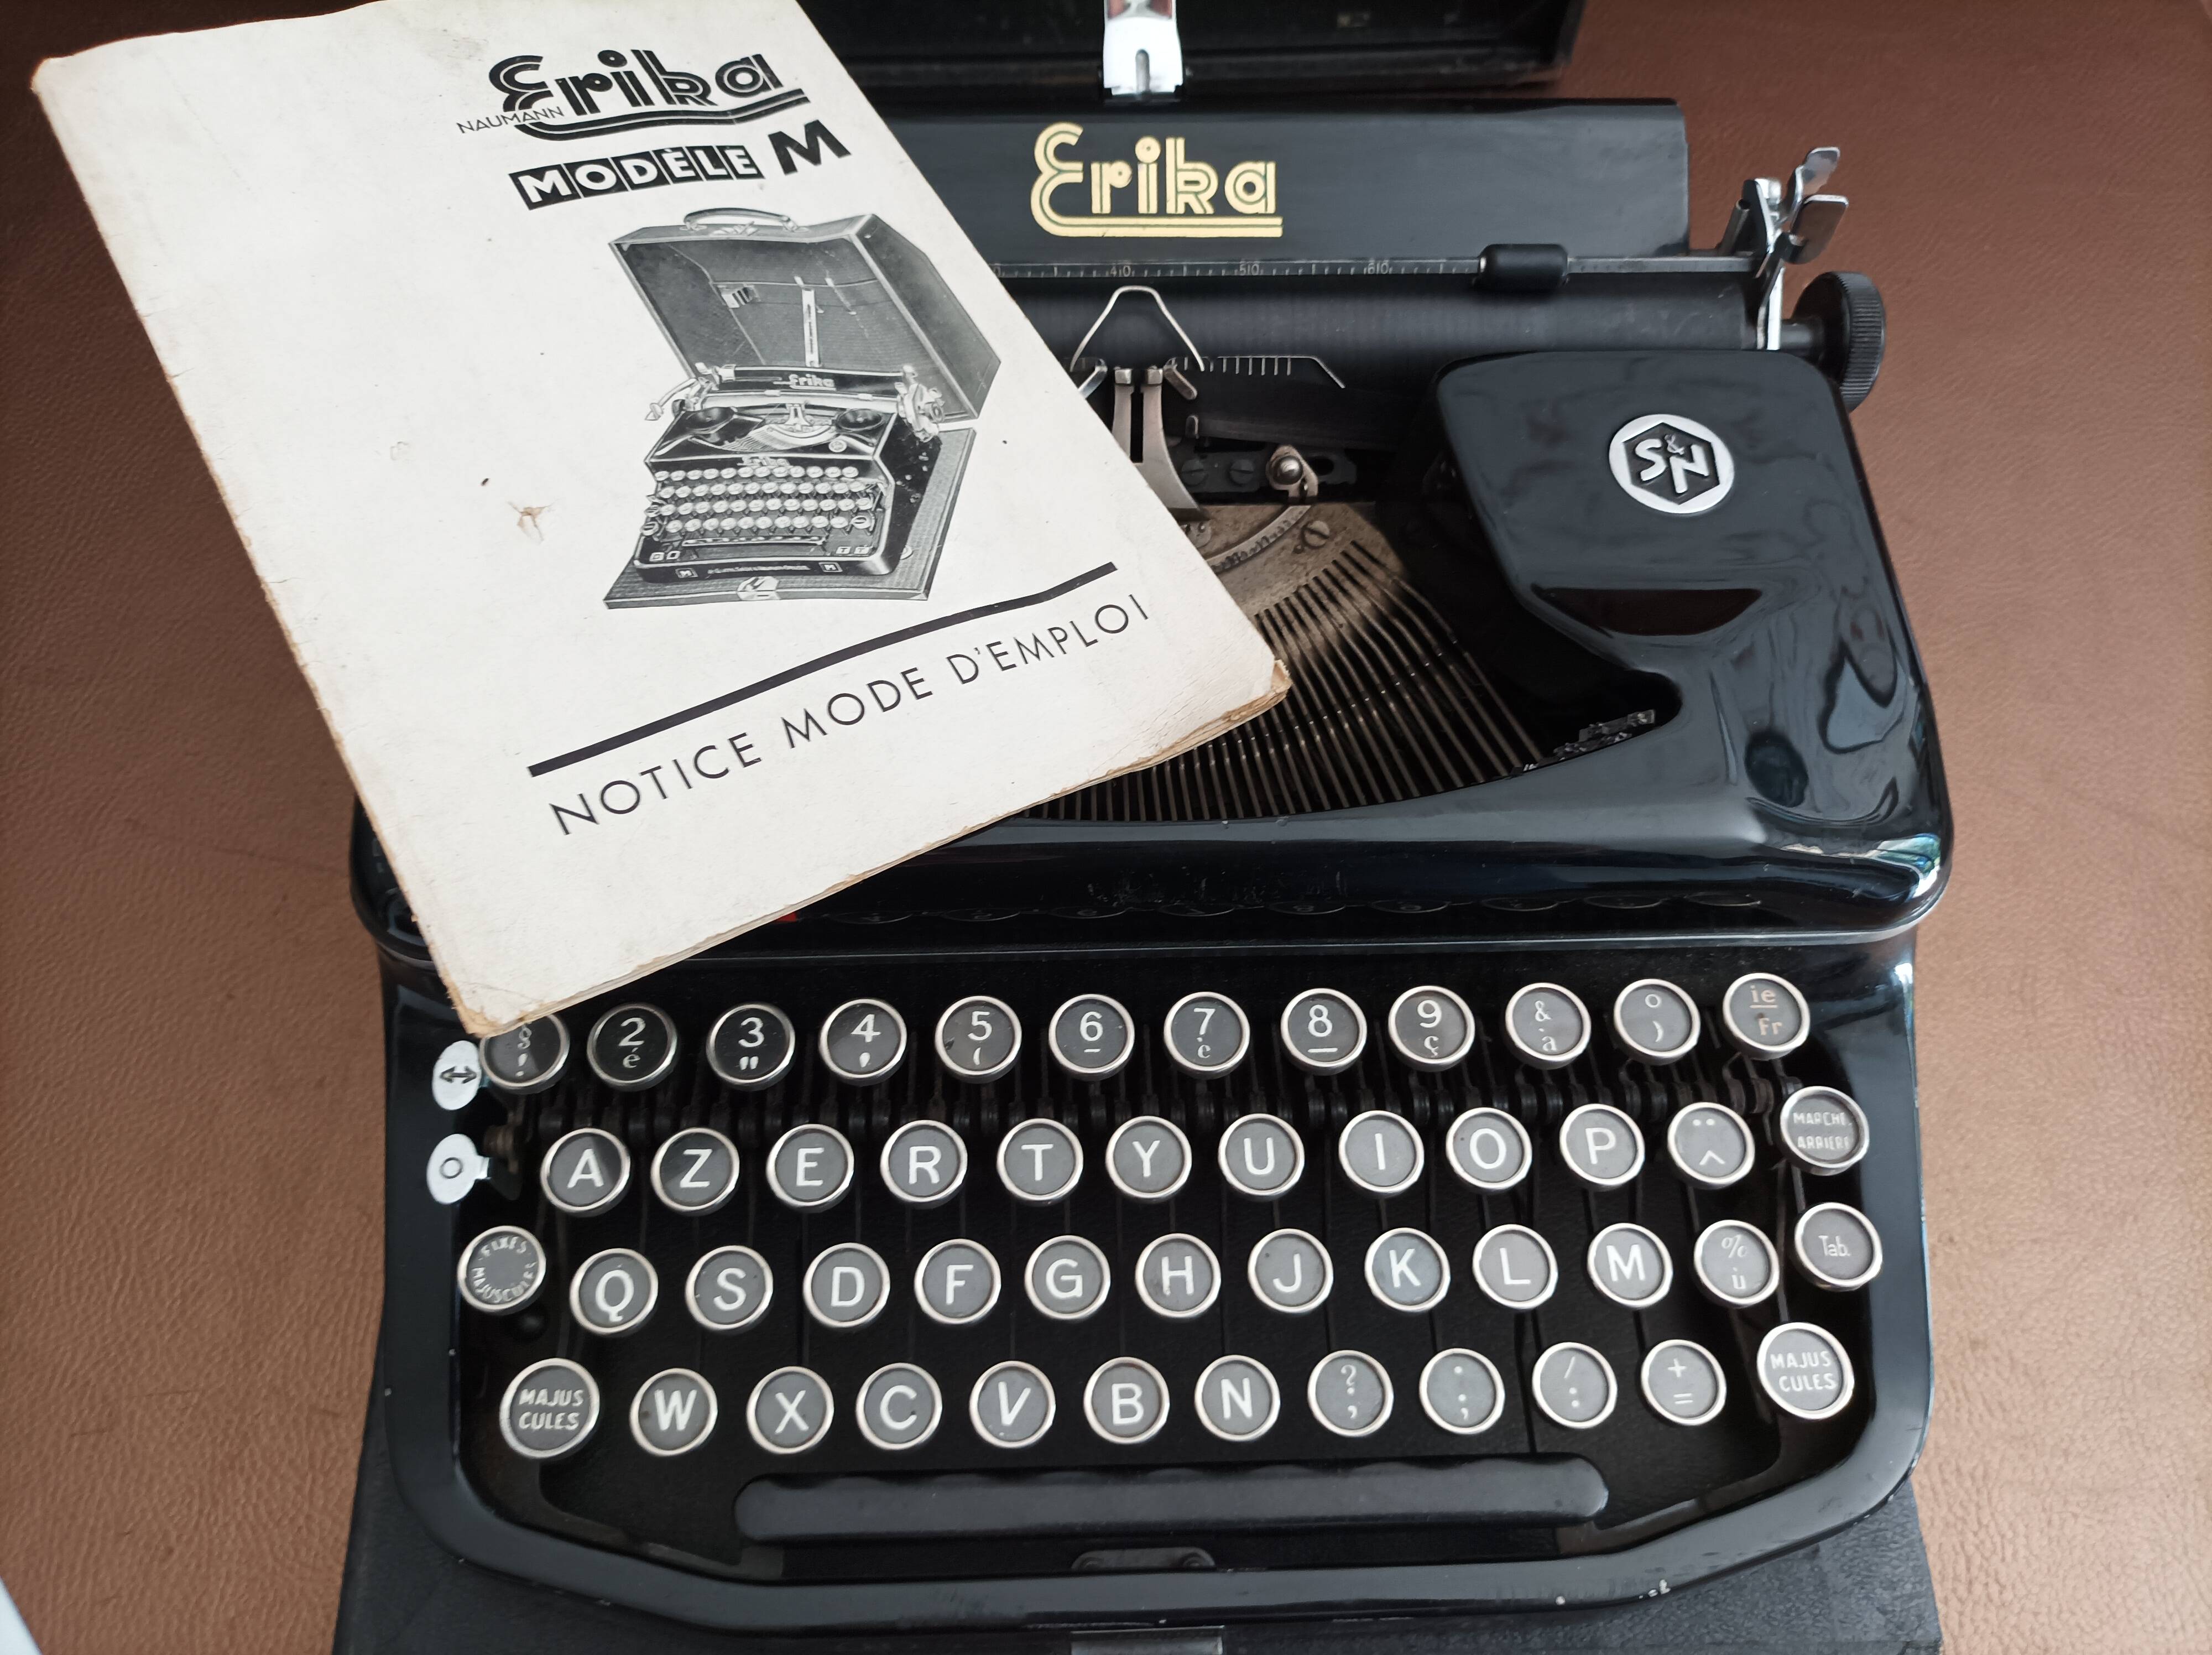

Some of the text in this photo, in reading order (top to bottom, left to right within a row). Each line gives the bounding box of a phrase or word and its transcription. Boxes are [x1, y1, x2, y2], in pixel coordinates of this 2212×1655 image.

[489, 49, 810, 140] Erika
[456, 105, 565, 135] NAUMANN
[518, 119, 851, 206] MODÈLE M
[1030, 123, 1284, 238] Erika
[547, 593, 1150, 836] NOTICE MODE D'EMPLOI
[851, 1014, 881, 1043] 4
[968, 1011, 992, 1041] 5
[1080, 1011, 1103, 1042] 6
[1193, 1007, 1215, 1035] 7
[1308, 1004, 1333, 1037] 8
[1417, 1000, 1442, 1028] 9
[1535, 1000, 1551, 1022] &
[618, 1017, 646, 1047] 2
[738, 1017, 764, 1048] 3
[1196, 1037, 1211, 1059] è
[1423, 1034, 1440, 1059] ç
[1537, 1028, 1558, 1052] à
[1653, 1021, 1664, 1042] )
[622, 1047, 643, 1069] é
[973, 1047, 981, 1065] (
[909, 1146, 941, 1184] R
[1021, 1144, 1053, 1181] T
[1132, 1140, 1160, 1178] Y
[1244, 1137, 1275, 1175] U
[1375, 1133, 1386, 1170] I
[1469, 1128, 1507, 1169] O
[1585, 1127, 1616, 1165] P
[567, 1148, 604, 1188] A
[679, 1148, 712, 1188] Z
[796, 1147, 824, 1186] E
[1606, 1244, 1646, 1282] M
[1721, 1234, 1746, 1258] %
[946, 1264, 974, 1305] F
[1046, 1258, 1083, 1299] G
[1161, 1256, 1194, 1295] H
[1273, 1253, 1302, 1293] J
[1389, 1248, 1421, 1288] K
[1499, 1247, 1531, 1285] L
[594, 1269, 635, 1323] Q
[713, 1268, 747, 1311] S
[831, 1266, 865, 1307] D
[1564, 1356, 1575, 1379] /
[1667, 1359, 1687, 1378] +
[1770, 1351, 1832, 1369] MAJUS
[518, 1388, 585, 1408] MAJUS
[1221, 1377, 1253, 1419] N
[1340, 1365, 1357, 1395] ?
[1673, 1393, 1693, 1404] =
[1778, 1372, 1837, 1392] CULES
[518, 1411, 581, 1432] CULES
[654, 1389, 697, 1431] W
[775, 1390, 809, 1434] X
[880, 1385, 917, 1430] C
[998, 1381, 1031, 1426] V
[1112, 1383, 1144, 1425] B
